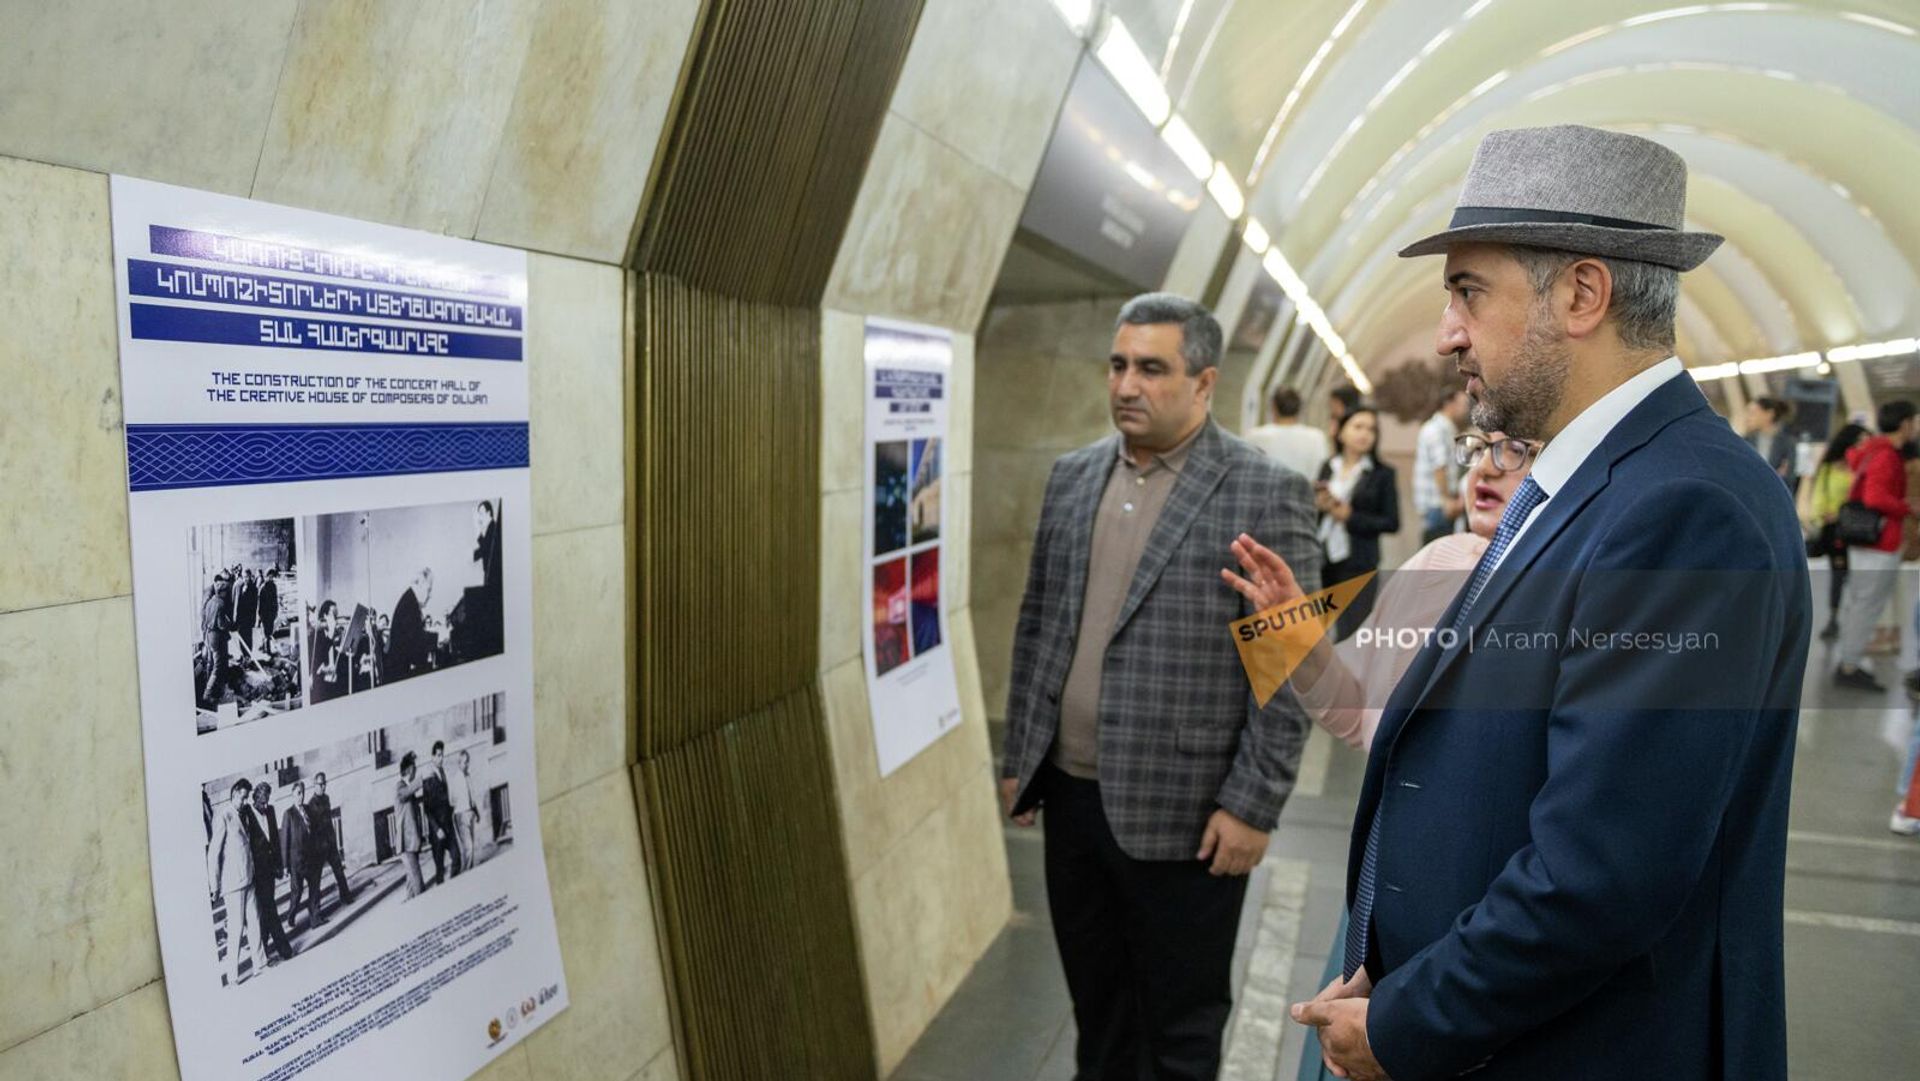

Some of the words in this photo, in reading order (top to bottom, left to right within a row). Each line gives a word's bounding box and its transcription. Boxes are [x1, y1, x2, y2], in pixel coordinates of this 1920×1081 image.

[157, 268, 361, 312] ԿՈՄՊՈԶԻՏՈՐՆԵՐԻ
[366, 292, 512, 327] ՍՏԵՂԾԱԳՈՐԾԱԿԱՆ
[260, 319, 302, 344] ՏԱՆ
[307, 323, 449, 354] ՀԱՄԵՐԳԱՍՐԱՀԸ
[211, 371, 241, 385] THE
[244, 373, 344, 388] CONSTRUCTION
[346, 376, 361, 388] OF
[365, 377, 387, 389] THE
[390, 378, 438, 390] CONCERT
[441, 380, 466, 391] HALL
[469, 381, 481, 391] OF
[207, 389, 236, 402] THE
[240, 390, 304, 402] CREATIVE
[308, 391, 349, 403] HOUSE
[352, 392, 367, 403] OF
[370, 392, 434, 404] COMPOSERS
[437, 394, 449, 404] OF
